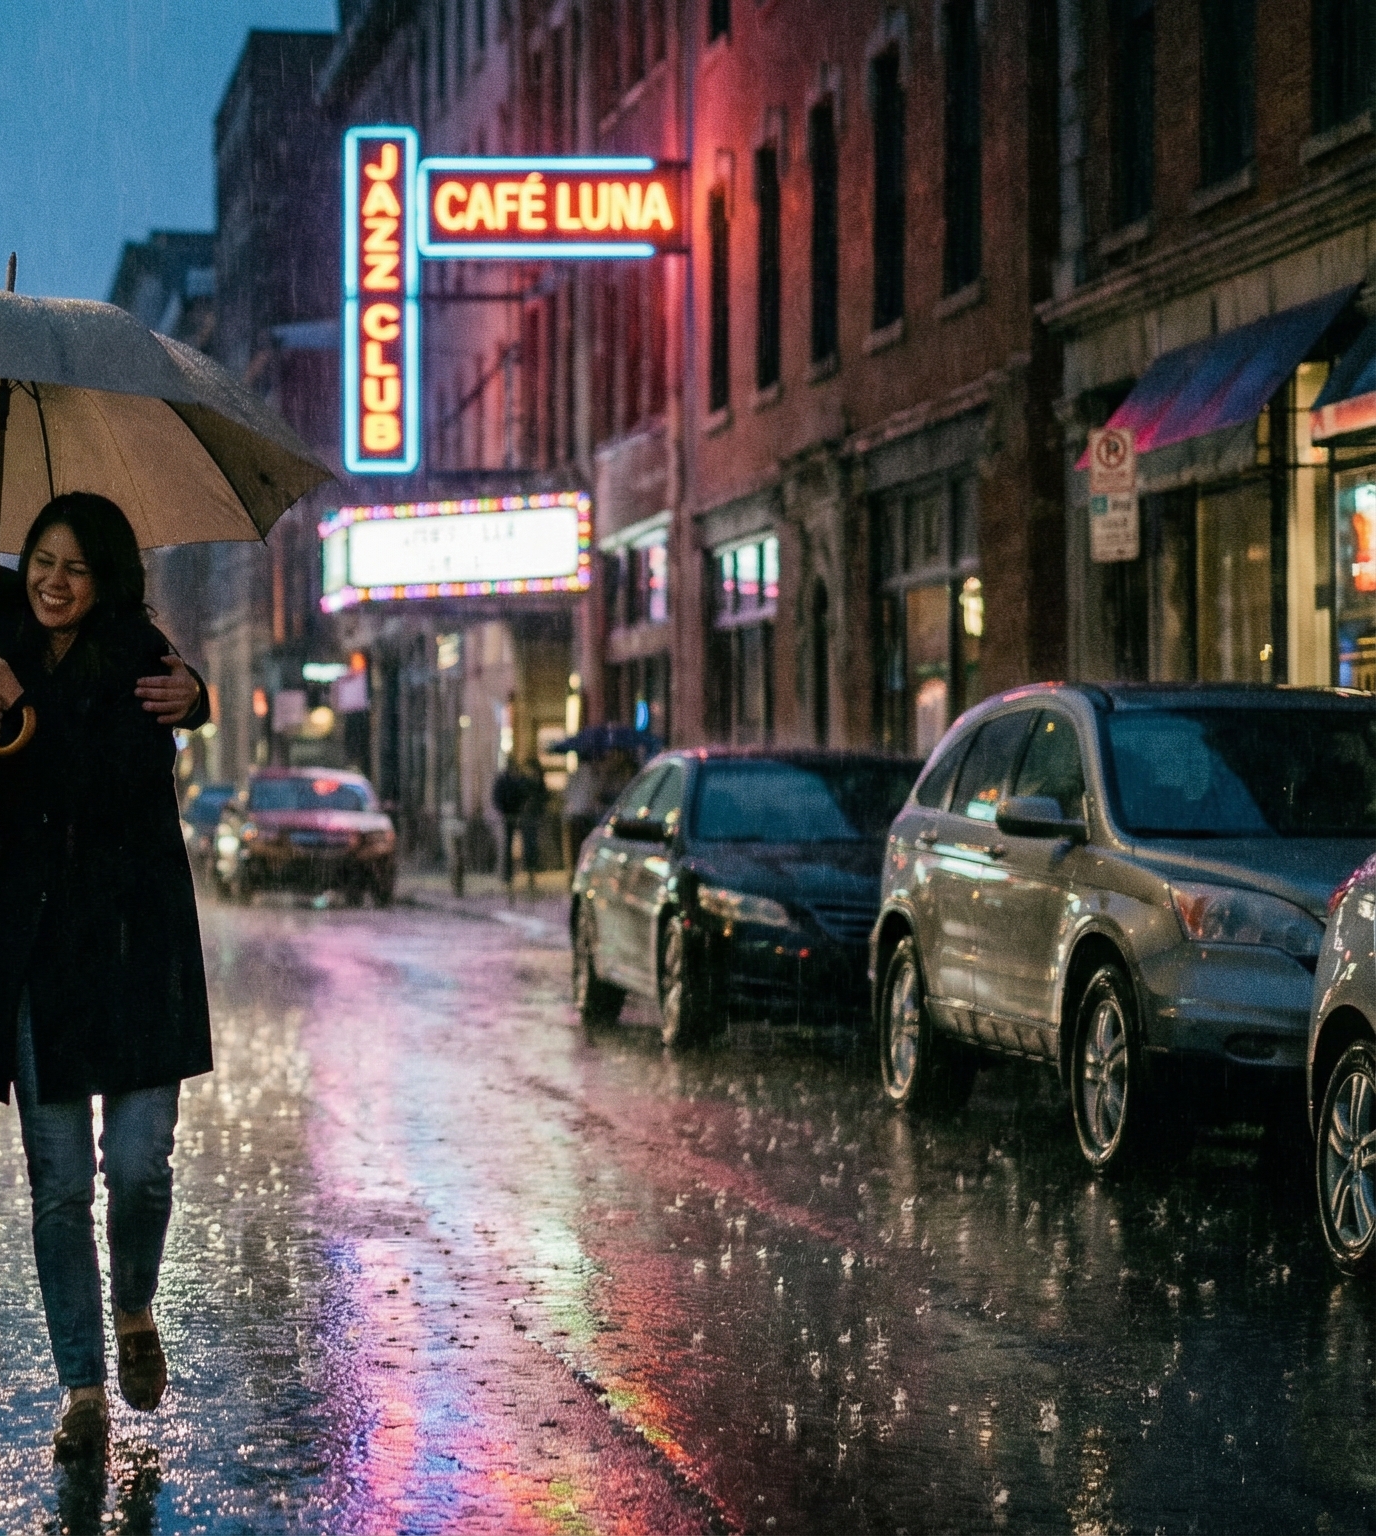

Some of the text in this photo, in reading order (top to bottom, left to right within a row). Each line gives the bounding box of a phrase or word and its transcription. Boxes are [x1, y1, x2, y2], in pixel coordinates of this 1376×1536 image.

[434, 171, 674, 232] CAFÉ LUNA
[362, 143, 401, 451] JAZZ CLUB
